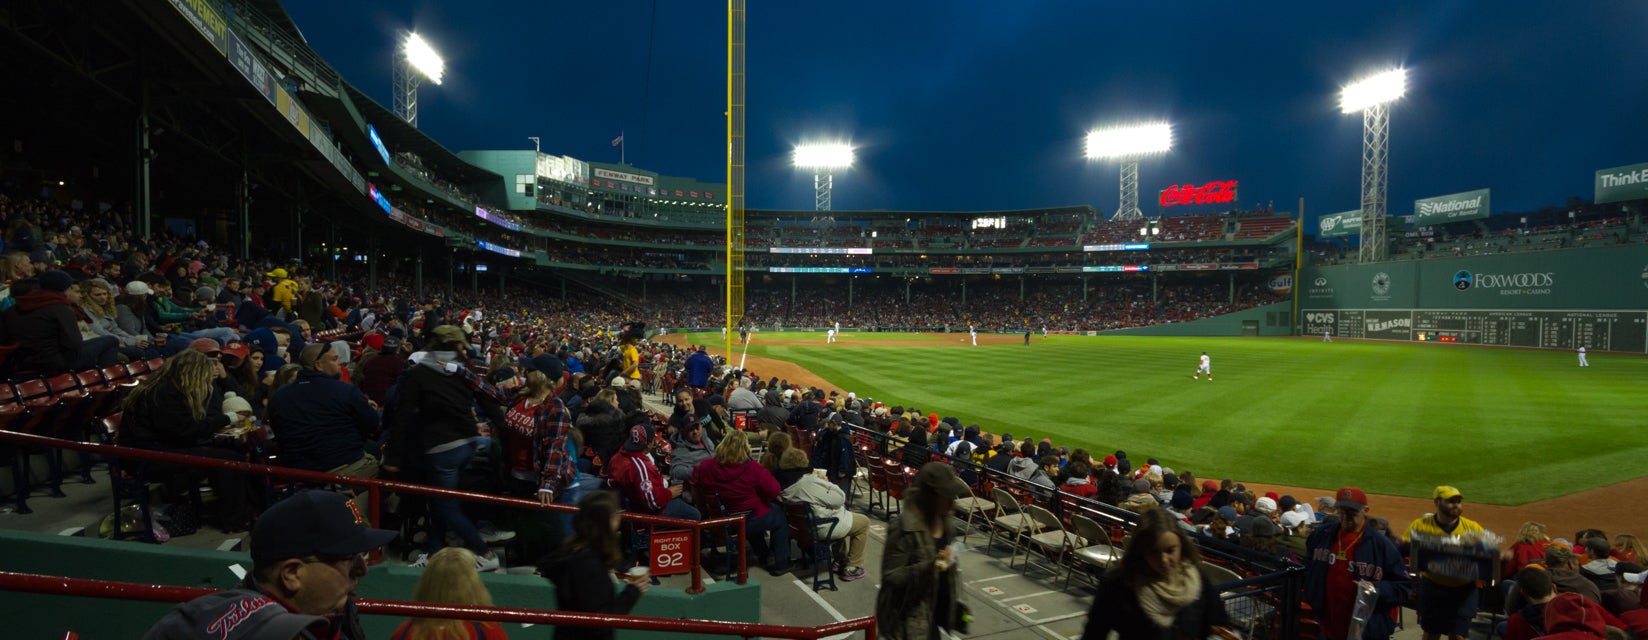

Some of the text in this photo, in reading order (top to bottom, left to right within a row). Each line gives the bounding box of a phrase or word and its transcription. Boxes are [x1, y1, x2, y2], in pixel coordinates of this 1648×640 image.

[1160, 179, 1238, 206] Coca-Cola
[1431, 196, 1480, 214] National
[1270, 277, 1291, 287] Gulf
[1475, 272, 1553, 288] FOXWOODS
[1315, 313, 1334, 323] CVS
[661, 543, 680, 551] BOX
[657, 552, 683, 568] 92
